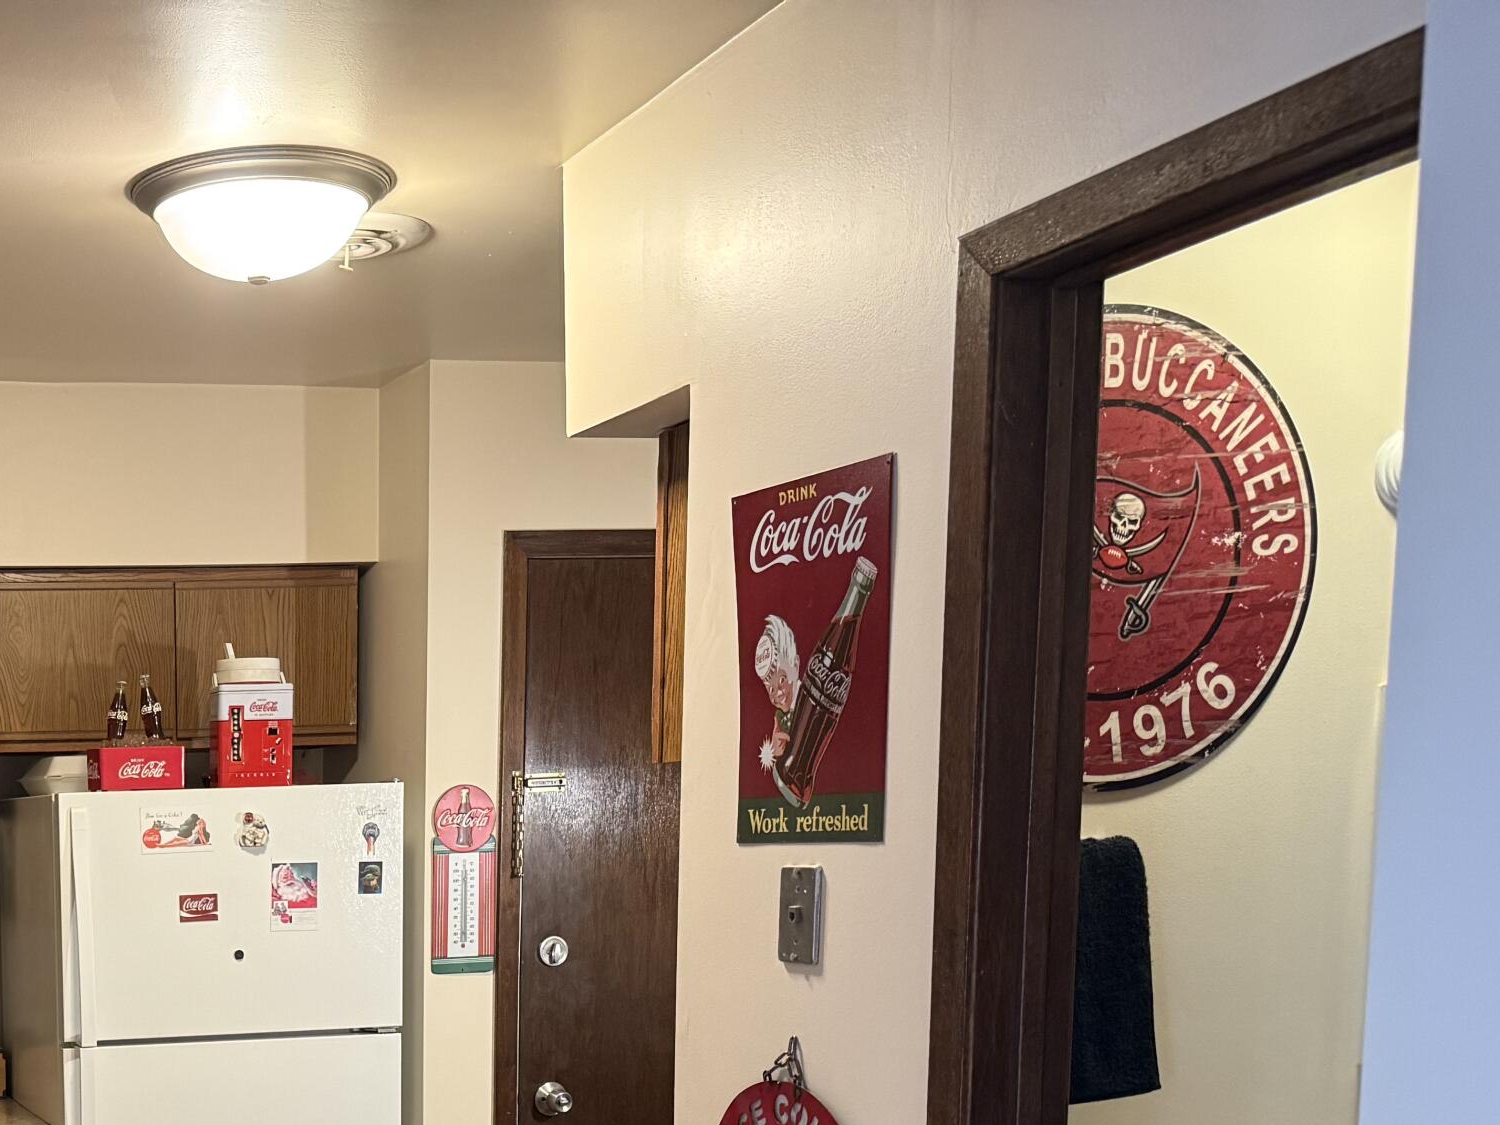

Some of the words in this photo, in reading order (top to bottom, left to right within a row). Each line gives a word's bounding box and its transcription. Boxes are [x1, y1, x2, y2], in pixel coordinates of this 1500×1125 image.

[1104, 332, 1299, 558] BUCCANEERS
[779, 483, 817, 506] DRINK
[749, 486, 873, 573] Coca-Cola
[1099, 661, 1237, 764] 1976
[118, 760, 166, 778] Coca-Cola
[436, 806, 493, 829] Coca-Cola
[748, 807, 789, 835] Work
[795, 804, 869, 834] refreshed
[182, 896, 214, 912] Coca-Cola
